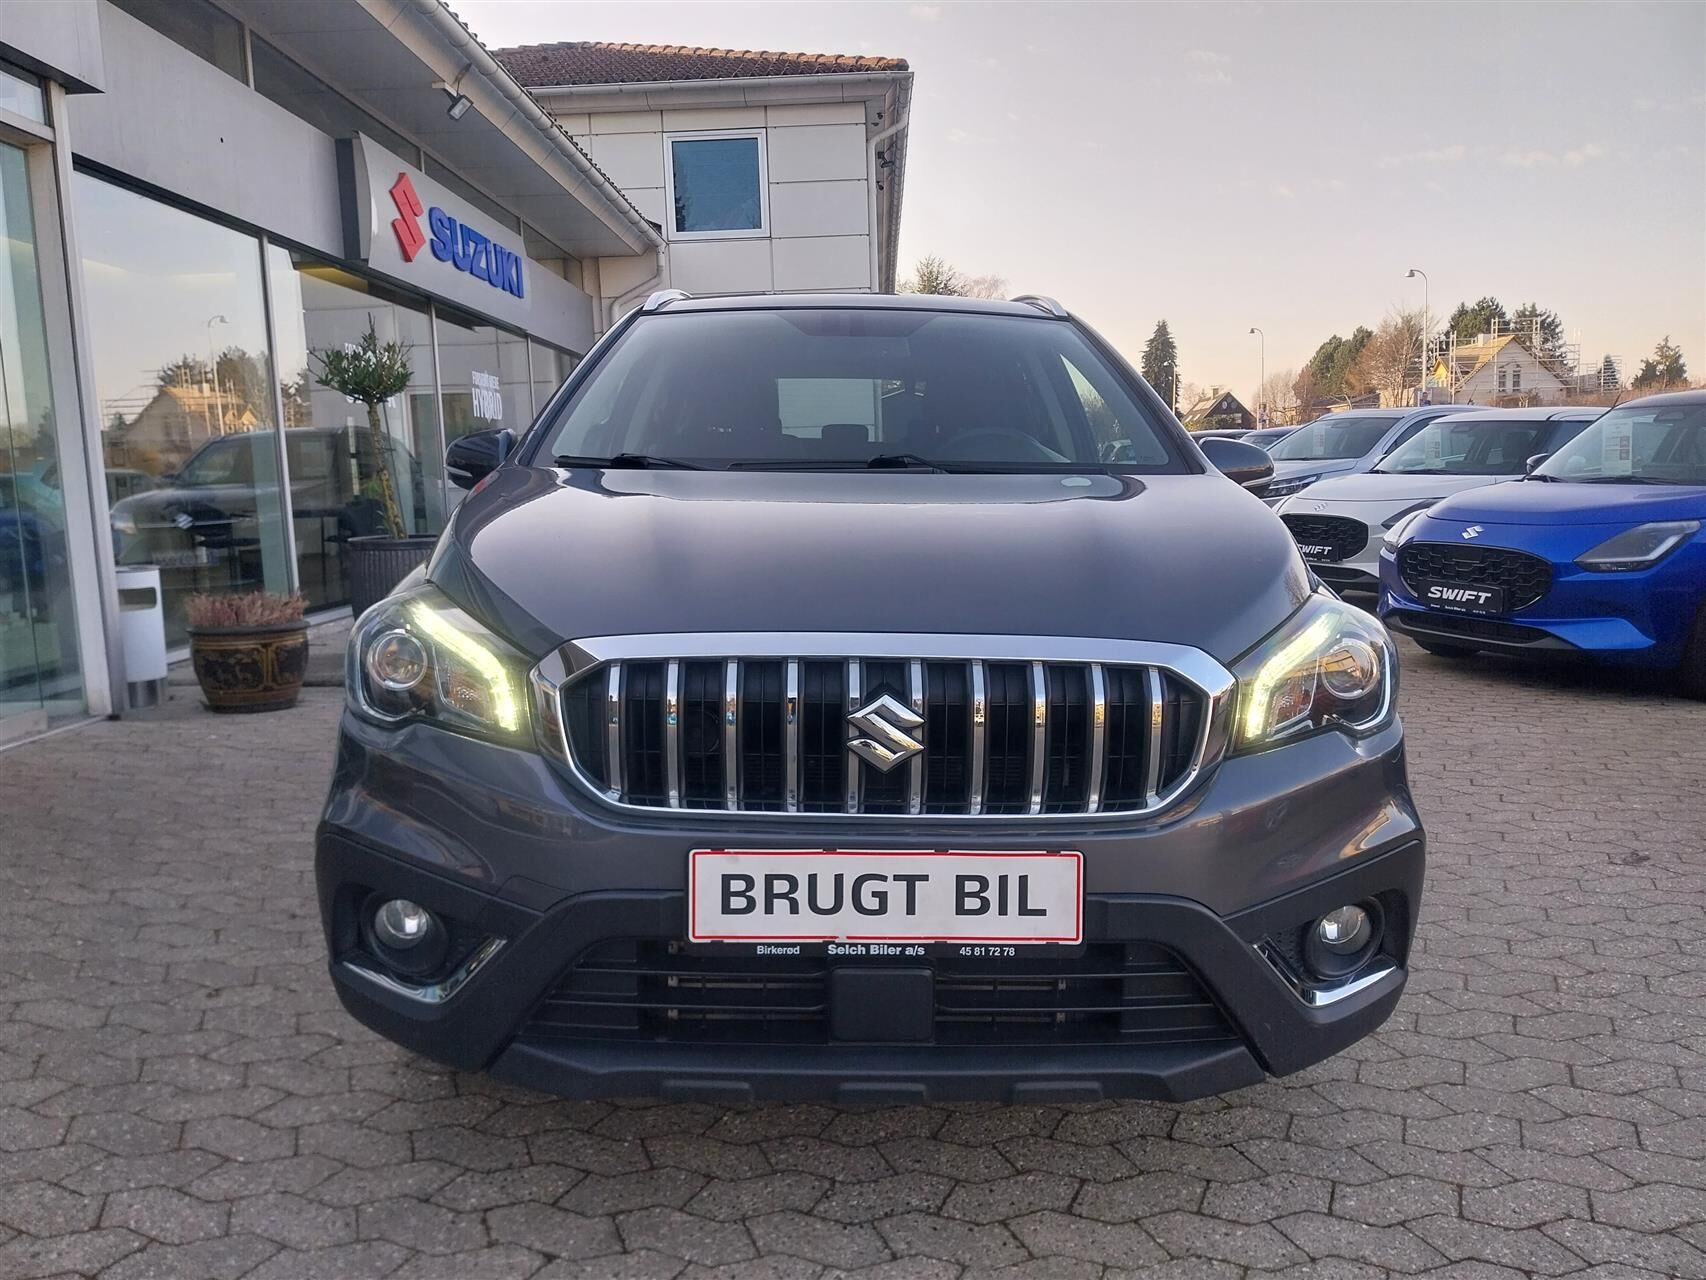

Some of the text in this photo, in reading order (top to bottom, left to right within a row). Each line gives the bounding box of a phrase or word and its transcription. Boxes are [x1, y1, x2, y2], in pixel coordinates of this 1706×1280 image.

[429, 206, 524, 299] SUZUKI
[1427, 586, 1492, 604] SWIFT
[720, 873, 1047, 917] BRUGT BIL
[827, 944, 866, 955] Selch
[869, 944, 902, 955] Biler
[904, 945, 926, 957] a/s
[959, 946, 972, 956] 45
[974, 946, 985, 956] 81
[988, 947, 1001, 956] 72
[1002, 947, 1016, 957] 78
